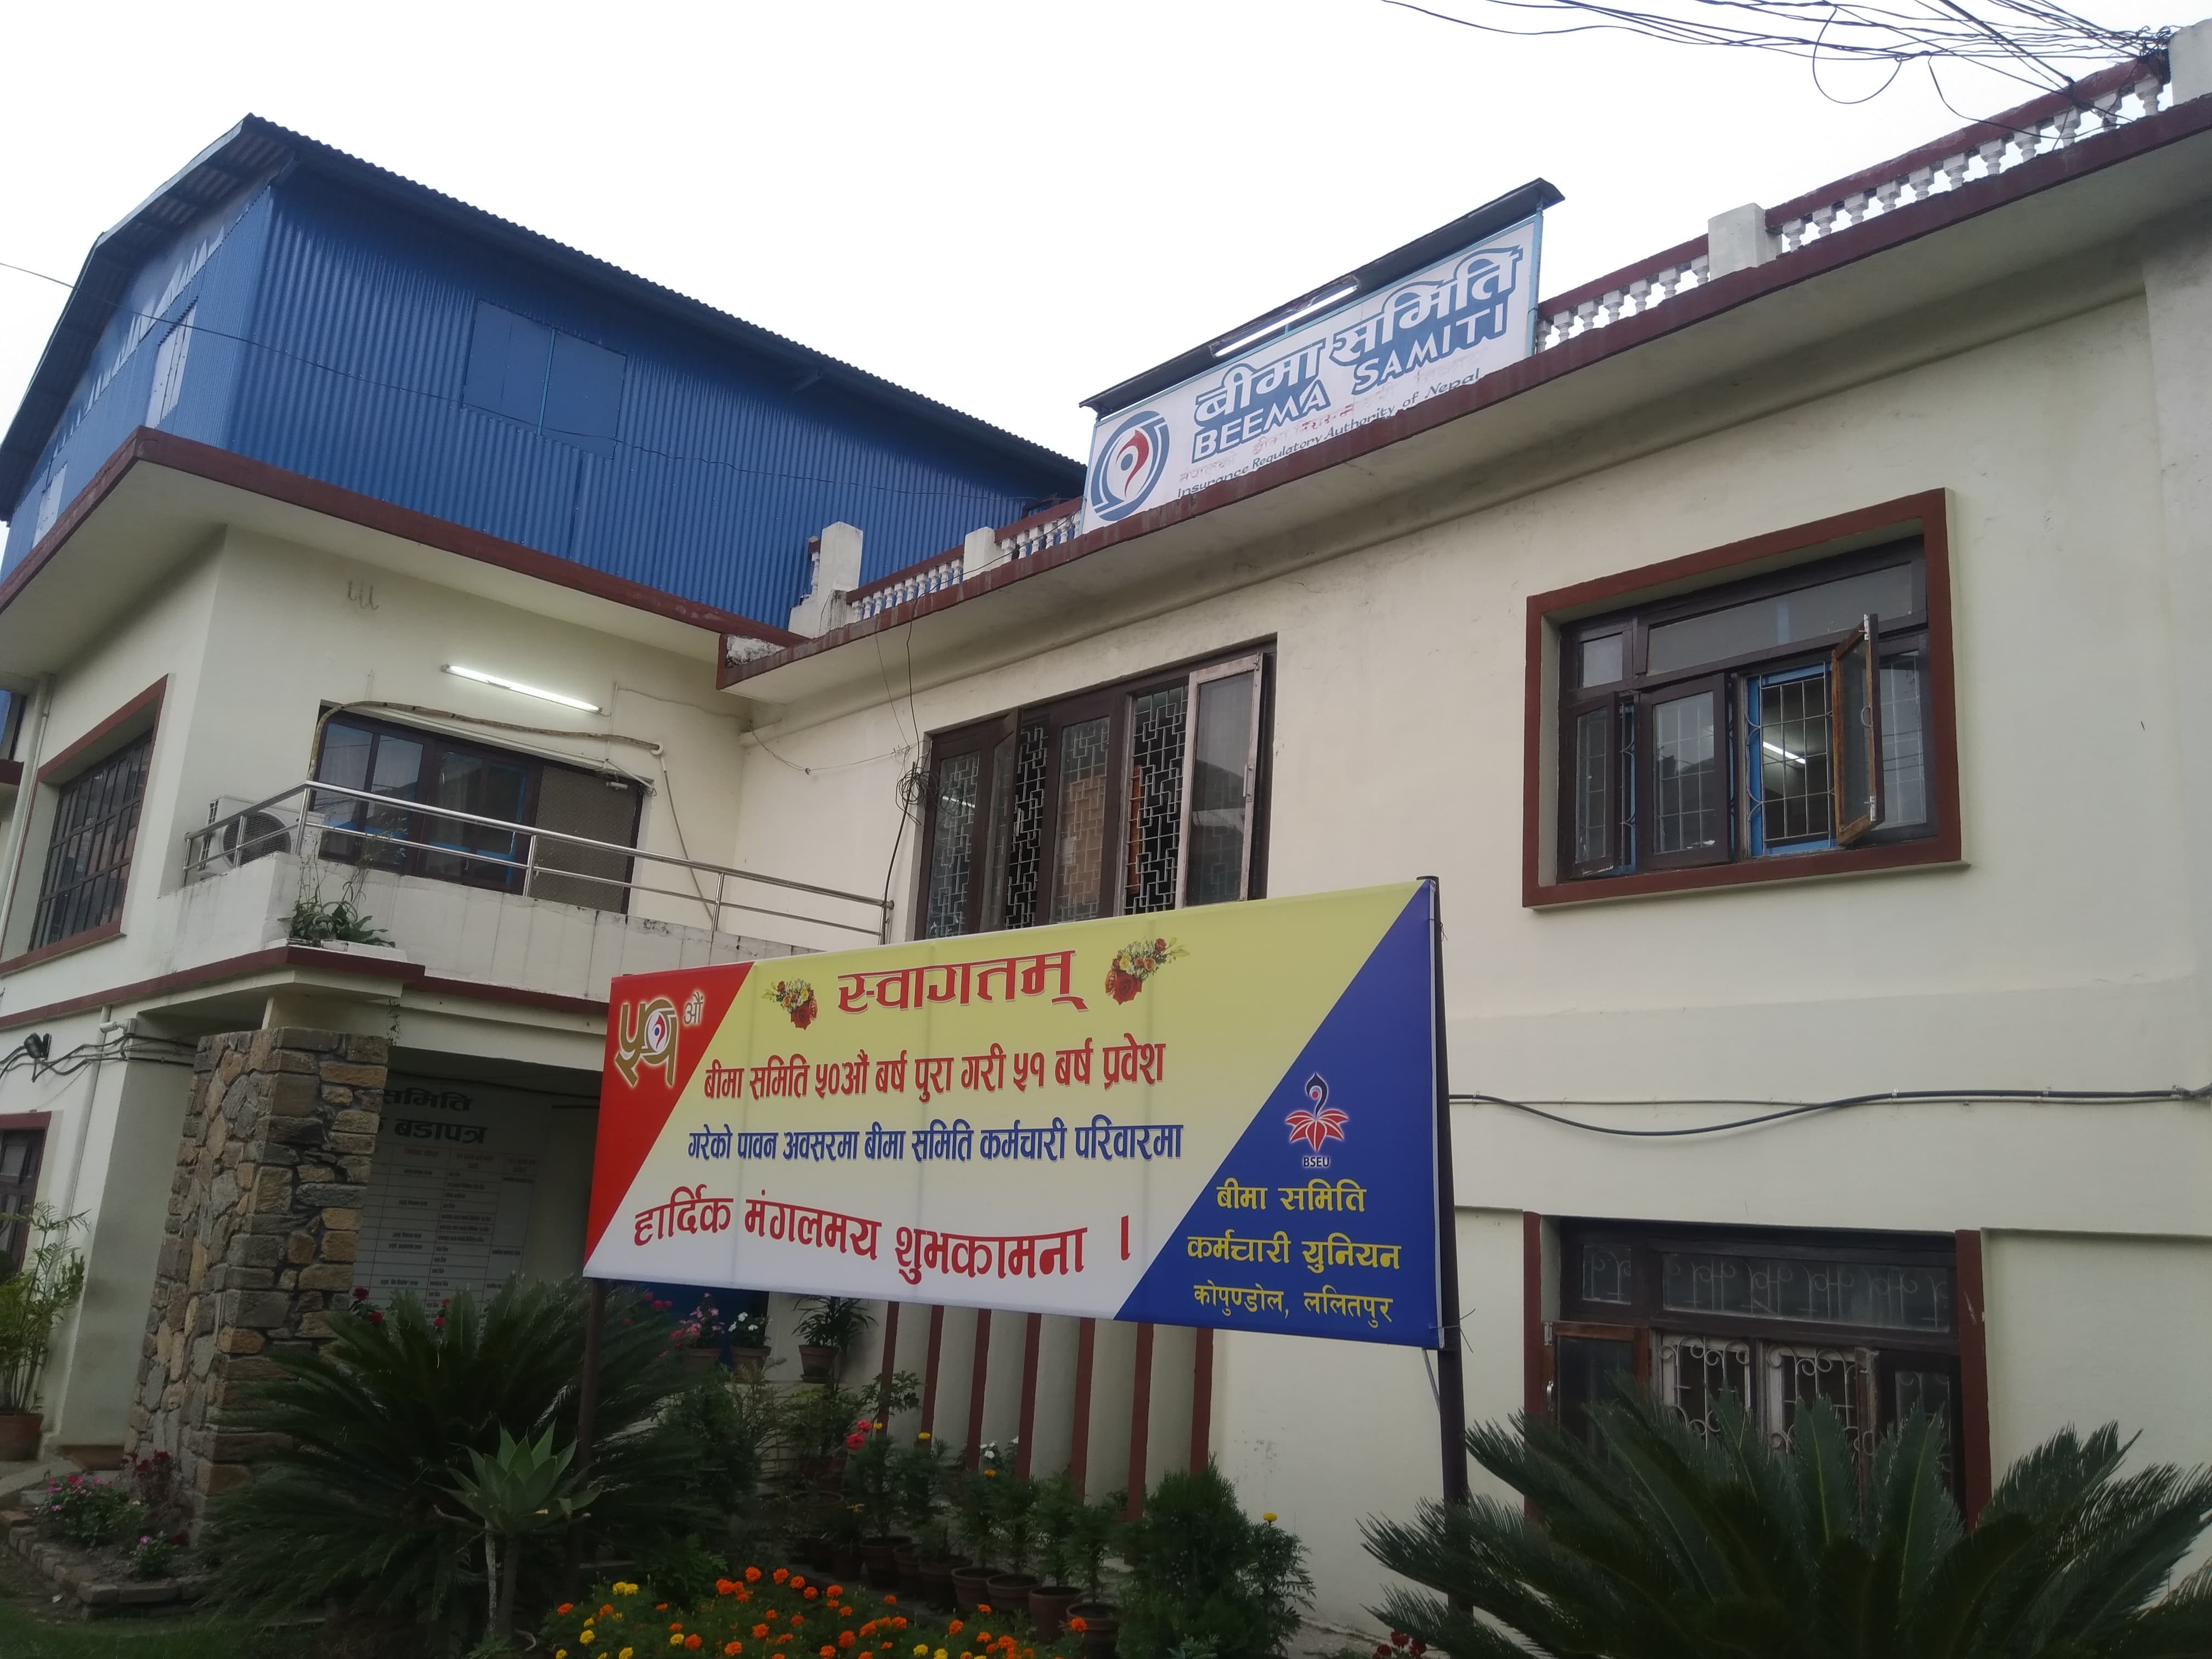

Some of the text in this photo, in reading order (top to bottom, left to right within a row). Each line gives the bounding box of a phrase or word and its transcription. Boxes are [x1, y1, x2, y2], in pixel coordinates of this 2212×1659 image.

[1194, 245, 1523, 429] बीमा समिति
[1192, 378, 1331, 464] BEEMA
[1351, 302, 1507, 396] SAMITI
[1177, 464, 1249, 498] Insurance
[1252, 433, 1323, 470] Regulatory
[1322, 404, 1396, 441] Authority
[1402, 391, 1420, 408] of
[1425, 368, 1480, 399] Nepal
[837, 950, 1088, 1012] स्वागतम्
[704, 1058, 744, 1099] बीमा
[749, 1053, 810, 1100] समिति
[874, 1049, 908, 1093] बर्ष
[915, 1057, 955, 1103] पुरा
[960, 1043, 1006, 1092] गरी
[1013, 1052, 1045, 1092] ५१
[1054, 1037, 1093, 1086] बर्ष
[1102, 1032, 1166, 1089] प्रवेश
[688, 1114, 1183, 1162] गरेको पावन अवसरमा बीमा समिति कर्मचारी परिवारमा
[1302, 1156, 1330, 1167] BSEU
[1216, 1177, 1367, 1212] बीमा समिति
[633, 1184, 734, 1246] हार्दिक
[744, 1190, 882, 1260] मंगलमय
[895, 1226, 1088, 1285] शुभकामना
[1187, 1228, 1402, 1274] कर्मचारी युनियन
[1193, 1280, 1393, 1329] कोपुण्डोल, ललितपुर
